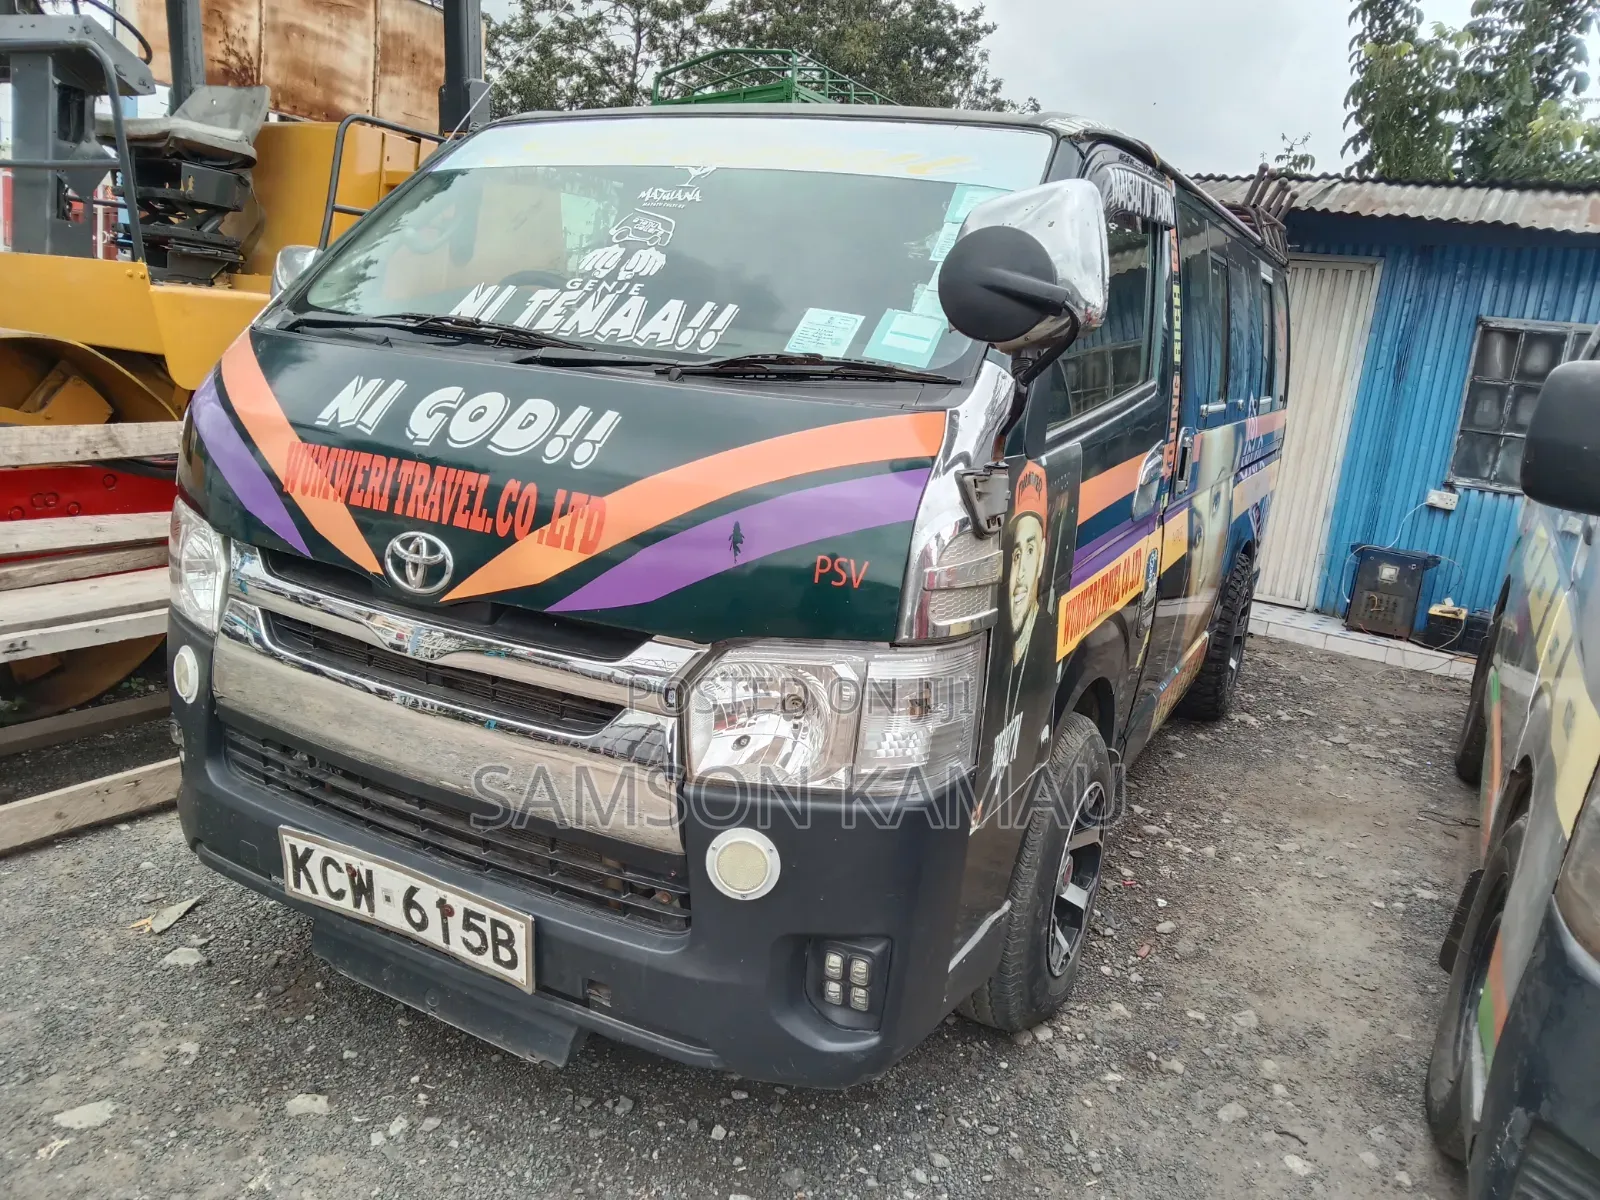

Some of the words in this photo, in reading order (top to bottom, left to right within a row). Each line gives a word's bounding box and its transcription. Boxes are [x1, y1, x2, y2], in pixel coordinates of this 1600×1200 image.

[449, 282, 518, 323] NI
[513, 288, 740, 354] TENAA!!
[314, 375, 407, 435] NI
[405, 386, 622, 470] GOD!!
[282, 441, 399, 512] WUMWERI
[814, 555, 869, 589] PSV
[288, 842, 376, 915] KCW
[402, 885, 519, 971] 615B
